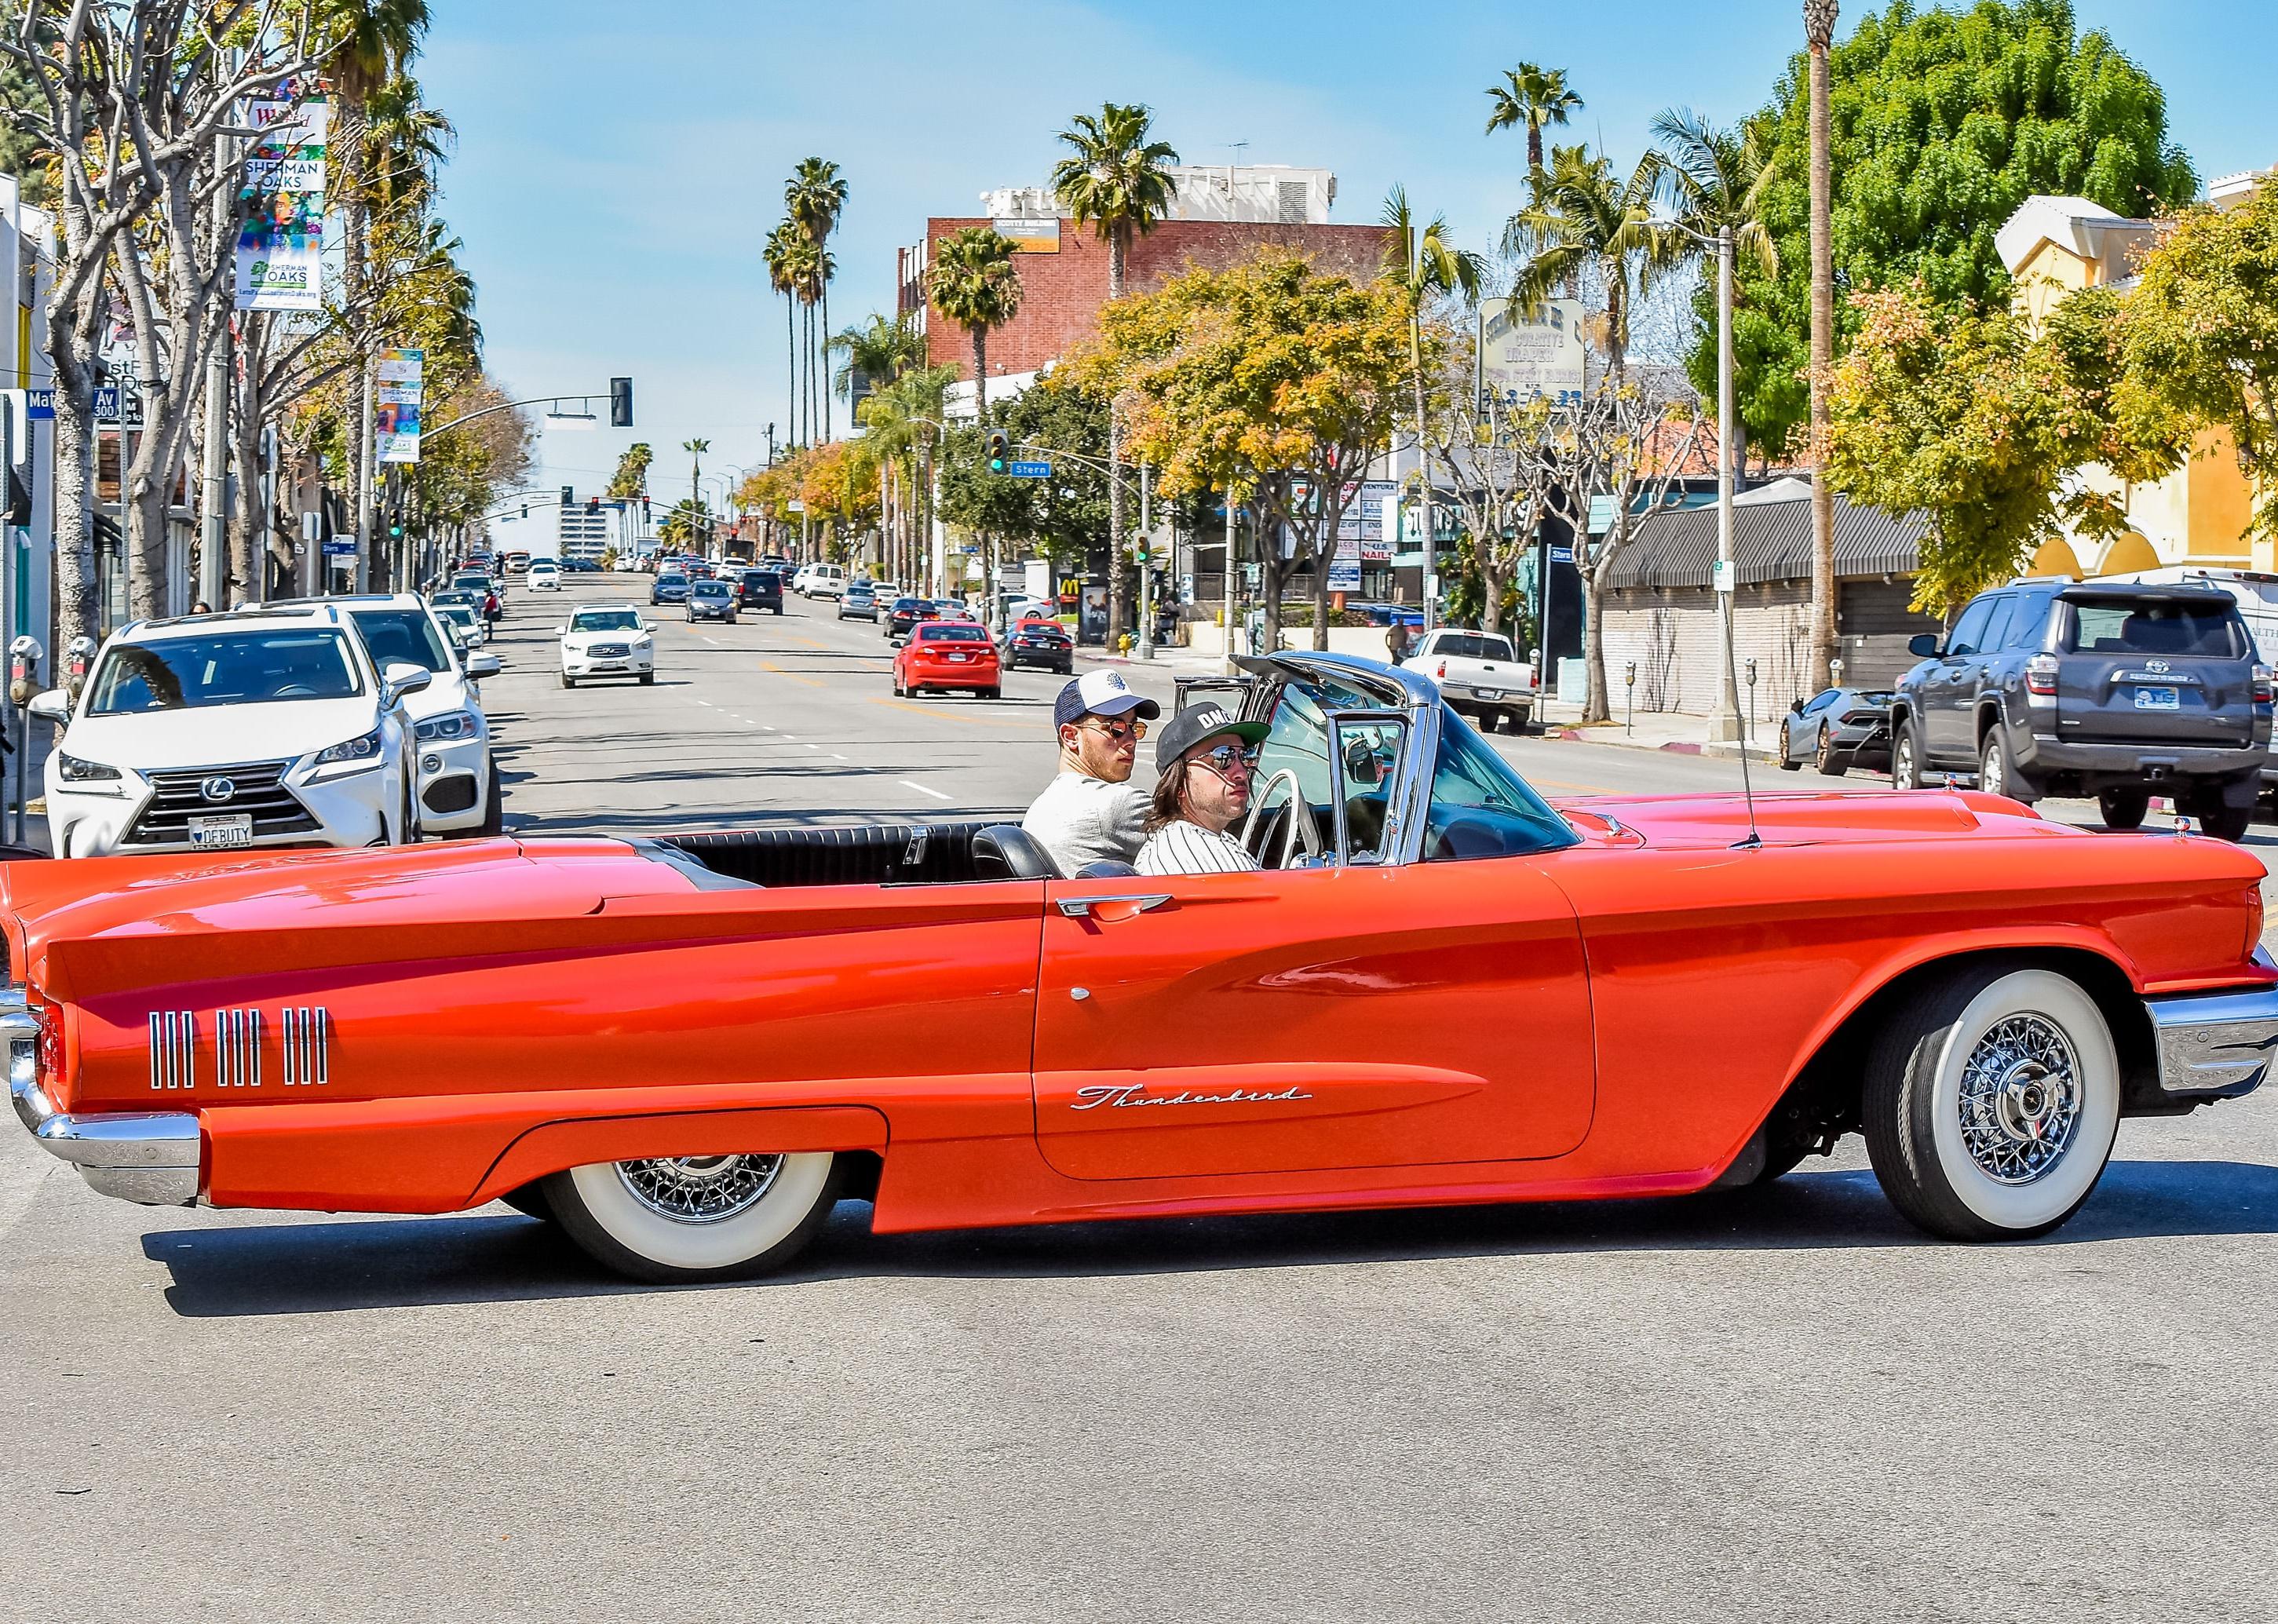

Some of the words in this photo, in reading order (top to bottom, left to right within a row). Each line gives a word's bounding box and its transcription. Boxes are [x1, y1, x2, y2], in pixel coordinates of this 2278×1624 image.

[246, 161, 317, 174] SHERMAN
[263, 176, 301, 188] OAKS
[268, 271, 308, 283] OAKS
[29, 392, 57, 408] Mat
[96, 390, 114, 406] Av
[94, 406, 115, 417] 300
[1016, 465, 1046, 474] Stern
[1552, 550, 1571, 559] Stern
[1070, 1083, 1313, 1110] Thunderbird
